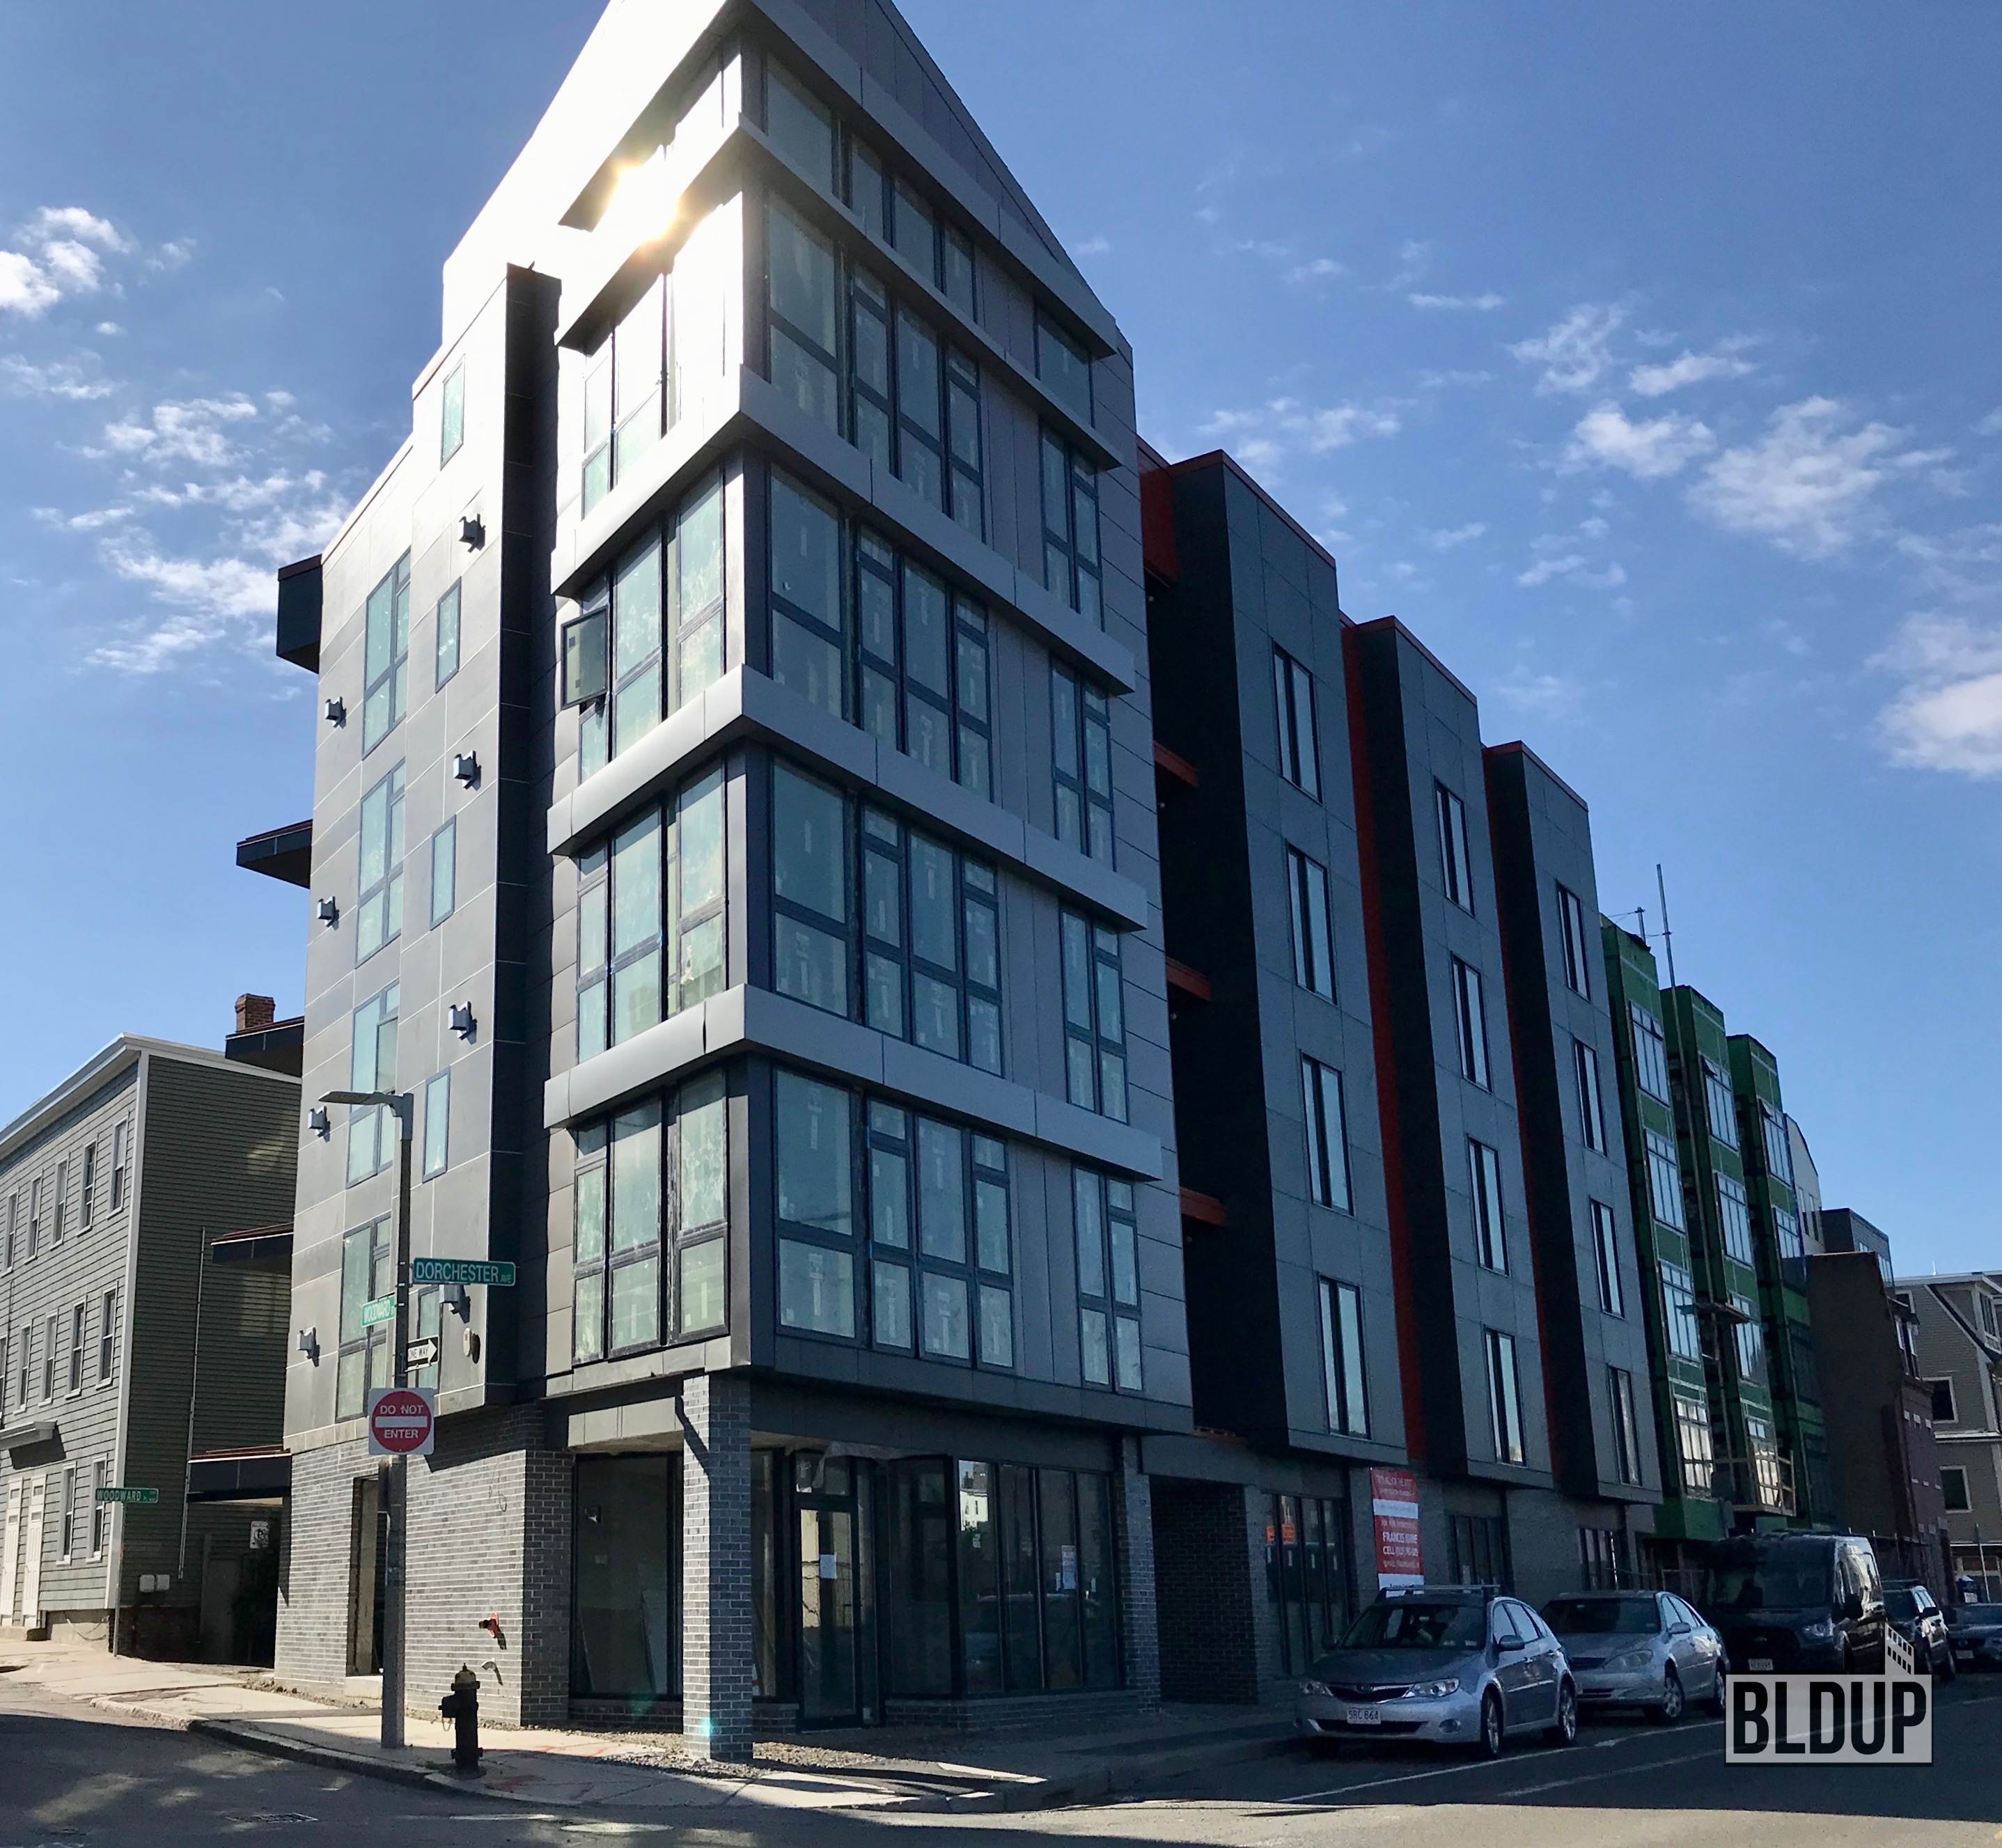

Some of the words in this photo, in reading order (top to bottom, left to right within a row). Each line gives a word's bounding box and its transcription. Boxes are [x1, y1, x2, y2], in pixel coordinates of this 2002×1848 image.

[416, 1261, 499, 1283] DORCHESTER
[500, 1274, 512, 1283] AVE
[408, 1348, 418, 1359] ONE
[419, 1345, 429, 1357] WAY
[380, 1405, 396, 1414] DO
[400, 1405, 423, 1414] NOT
[384, 1430, 419, 1439] ENTER
[97, 1490, 141, 1501] WOODWARD
